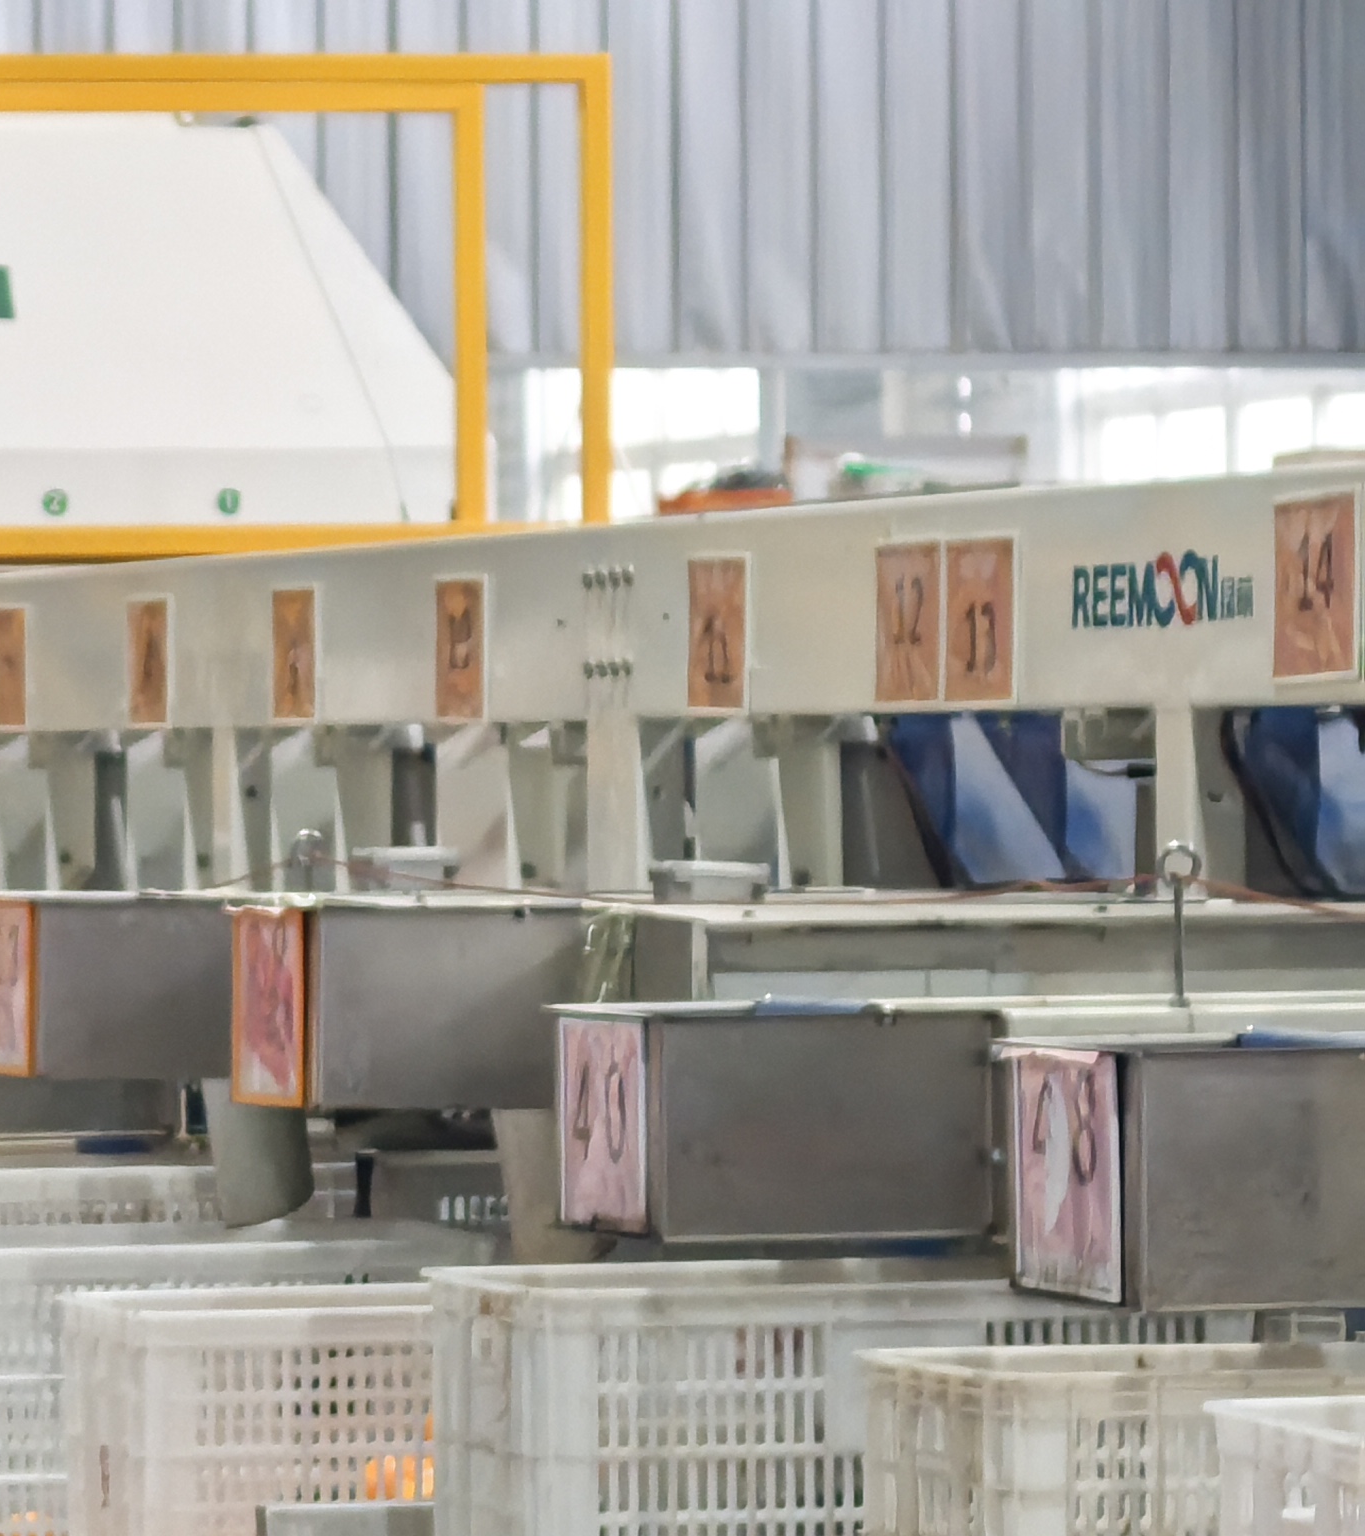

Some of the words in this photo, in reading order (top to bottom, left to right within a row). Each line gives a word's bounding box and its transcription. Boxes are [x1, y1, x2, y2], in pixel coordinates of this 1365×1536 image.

[1072, 549, 1219, 628] REEMOON
[1295, 531, 1335, 611] 14
[572, 1061, 626, 1162] 40
